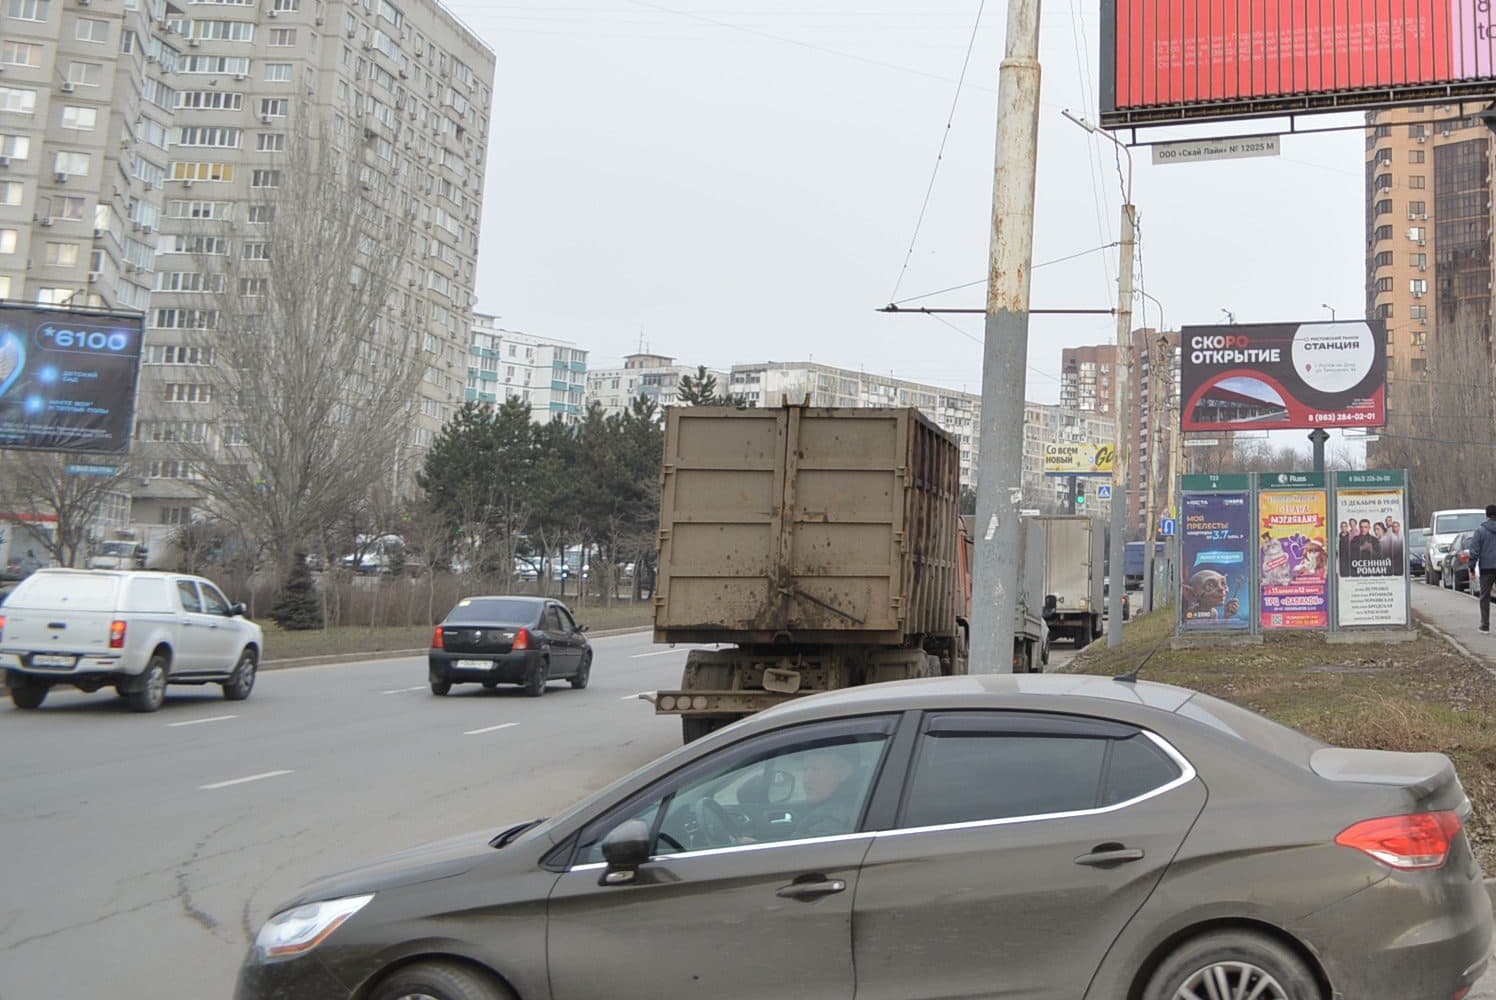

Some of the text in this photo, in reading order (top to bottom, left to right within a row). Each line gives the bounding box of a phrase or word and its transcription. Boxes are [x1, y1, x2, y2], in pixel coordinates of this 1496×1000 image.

[1191, 335, 1249, 349] СКОРО
[1304, 341, 1360, 351] СТАНЦИЯ
[1191, 348, 1280, 365] ОТКРЫТИЕ
[1348, 499, 1376, 507] ДЕКАБРЯ
[1351, 557, 1392, 568] ОСЕННИЙ
[1356, 567, 1387, 575] РОМАН
